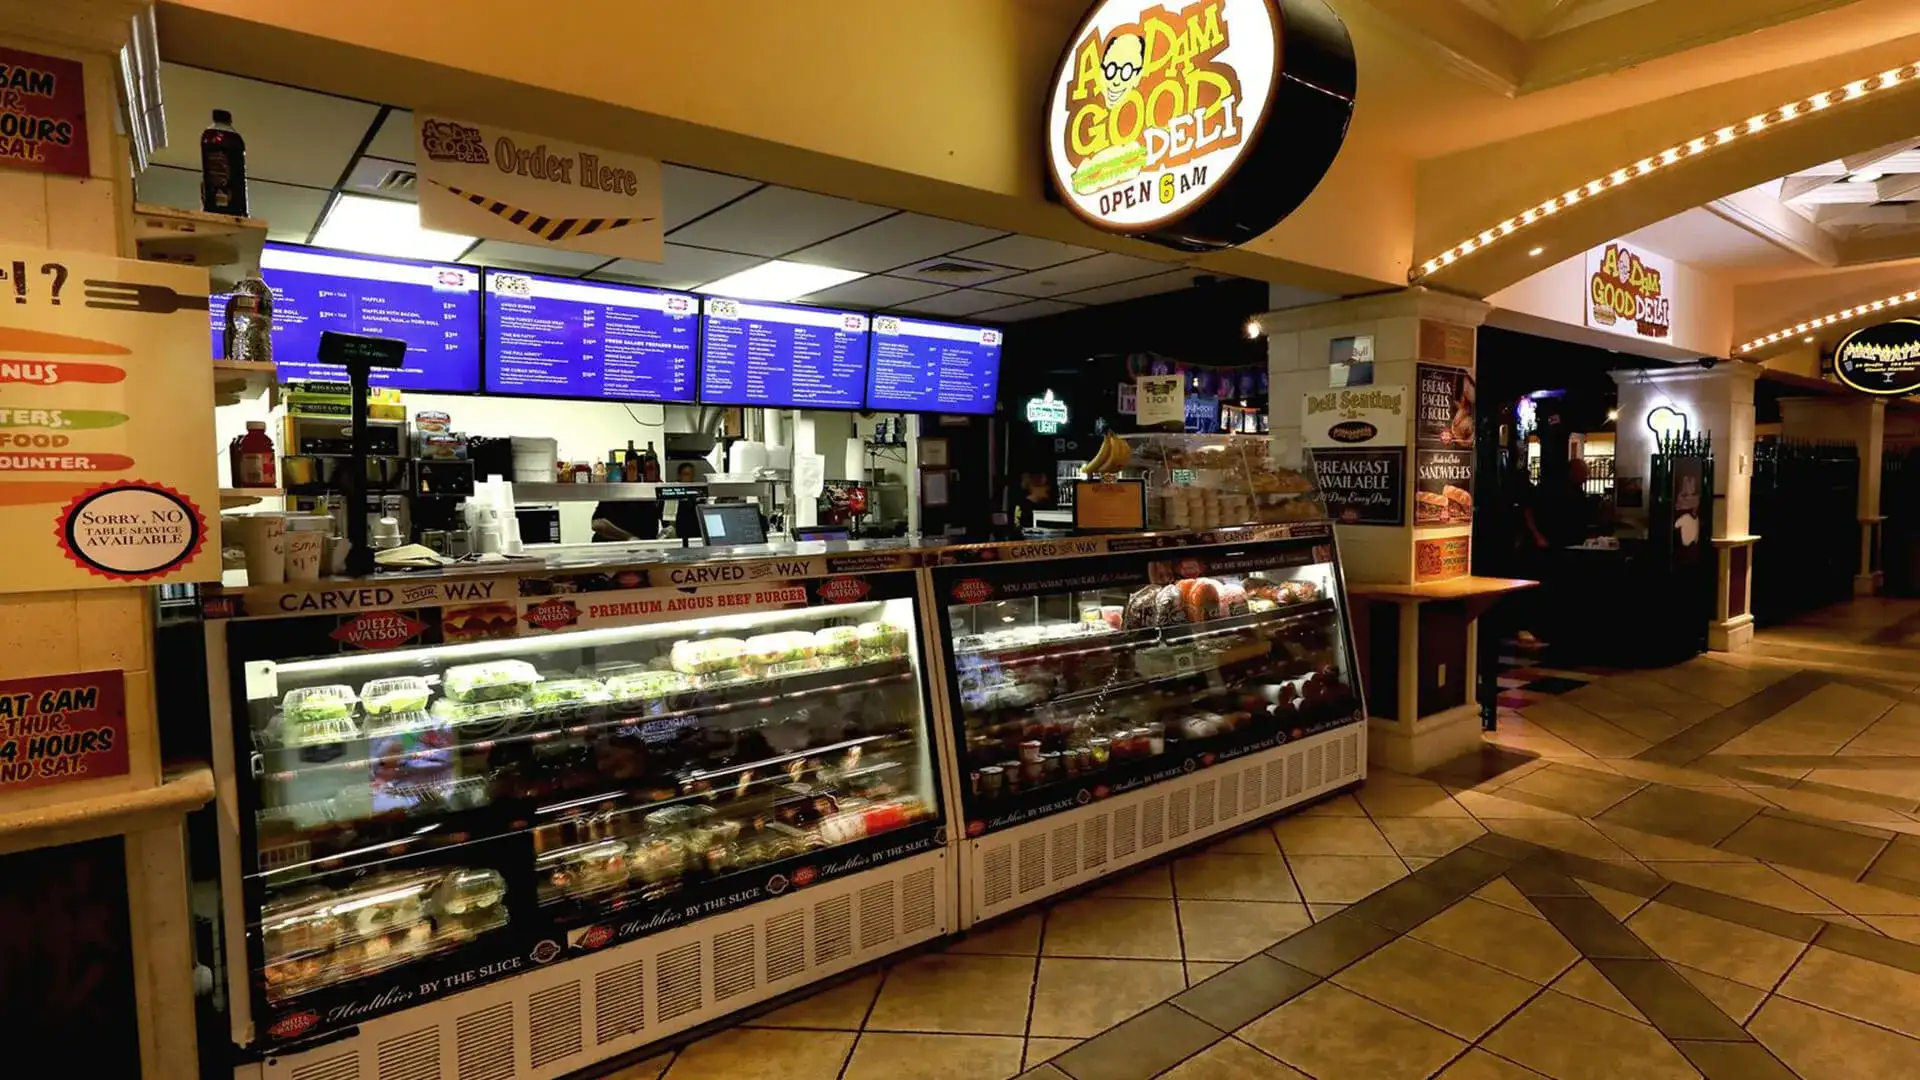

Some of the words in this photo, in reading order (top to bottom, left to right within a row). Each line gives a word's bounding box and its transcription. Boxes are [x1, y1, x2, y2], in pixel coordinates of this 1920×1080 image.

[1072, 40, 1102, 101] A
[1142, 3, 1226, 79] DAM
[1071, 70, 1234, 157] GOOD
[1143, 95, 1238, 167] DELI
[494, 136, 574, 185] Order
[578, 152, 638, 198] Here
[1098, 179, 1152, 216] OPEN
[1157, 172, 1176, 205] 6
[1179, 165, 1209, 195] AM
[1604, 246, 1619, 278] A
[1629, 258, 1659, 296] DAM
[1592, 274, 1637, 316] GOOD
[1635, 294, 1668, 327] DELI
[1307, 393, 1337, 416] Deli
[1339, 390, 1402, 416] Seating
[1428, 407, 1451, 421] ROLLS
[1315, 459, 1391, 475] BREAKFAST
[1419, 464, 1472, 480] SANDWICHES
[1319, 474, 1390, 490] AVAILABLE
[151, 509, 184, 525] NO
[85, 526, 128, 536] TABLE
[130, 525, 184, 535] SERVICE
[86, 534, 184, 547] AVAILABLE
[1011, 543, 1057, 558] CARVED
[1075, 541, 1098, 553] WAY
[671, 565, 745, 585] CARVED
[776, 561, 811, 576] WAY
[278, 588, 394, 612] CARVED
[405, 588, 435, 601] YOUR
[444, 581, 495, 601] WAY
[826, 586, 861, 599] WATSON
[1001, 583, 1020, 593] YOU
[1021, 583, 1037, 592] ARE
[1039, 580, 1064, 589] WHAT
[538, 605, 559, 616] DIETZ
[588, 598, 662, 618] PREMIUM
[667, 595, 714, 611] ANGUS
[717, 591, 751, 607] BEEF
[756, 586, 808, 604] BURGER
[357, 616, 395, 631] DIETZ
[396, 615, 408, 627] &
[534, 612, 570, 624] WATSON
[348, 627, 409, 642] WATSON
[0, 692, 33, 719] AT
[37, 686, 99, 715] 6AM
[5, 711, 71, 738] THUR.
[27, 726, 115, 761] HOURS
[39, 754, 88, 778] SAT.
[1038, 803, 1053, 816] THE
[1053, 798, 1074, 812] SLICE
[821, 853, 872, 877] Healthier
[872, 850, 885, 863] BY
[885, 844, 904, 859] THE
[904, 836, 932, 853] SLICE
[619, 908, 685, 937] Healthier
[686, 903, 702, 917] BY
[703, 894, 728, 911] THE
[729, 886, 762, 905] SLICE
[326, 985, 415, 1024] Healthier
[419, 981, 440, 997] BY
[443, 970, 477, 989] THE
[479, 956, 522, 979] SLICE
